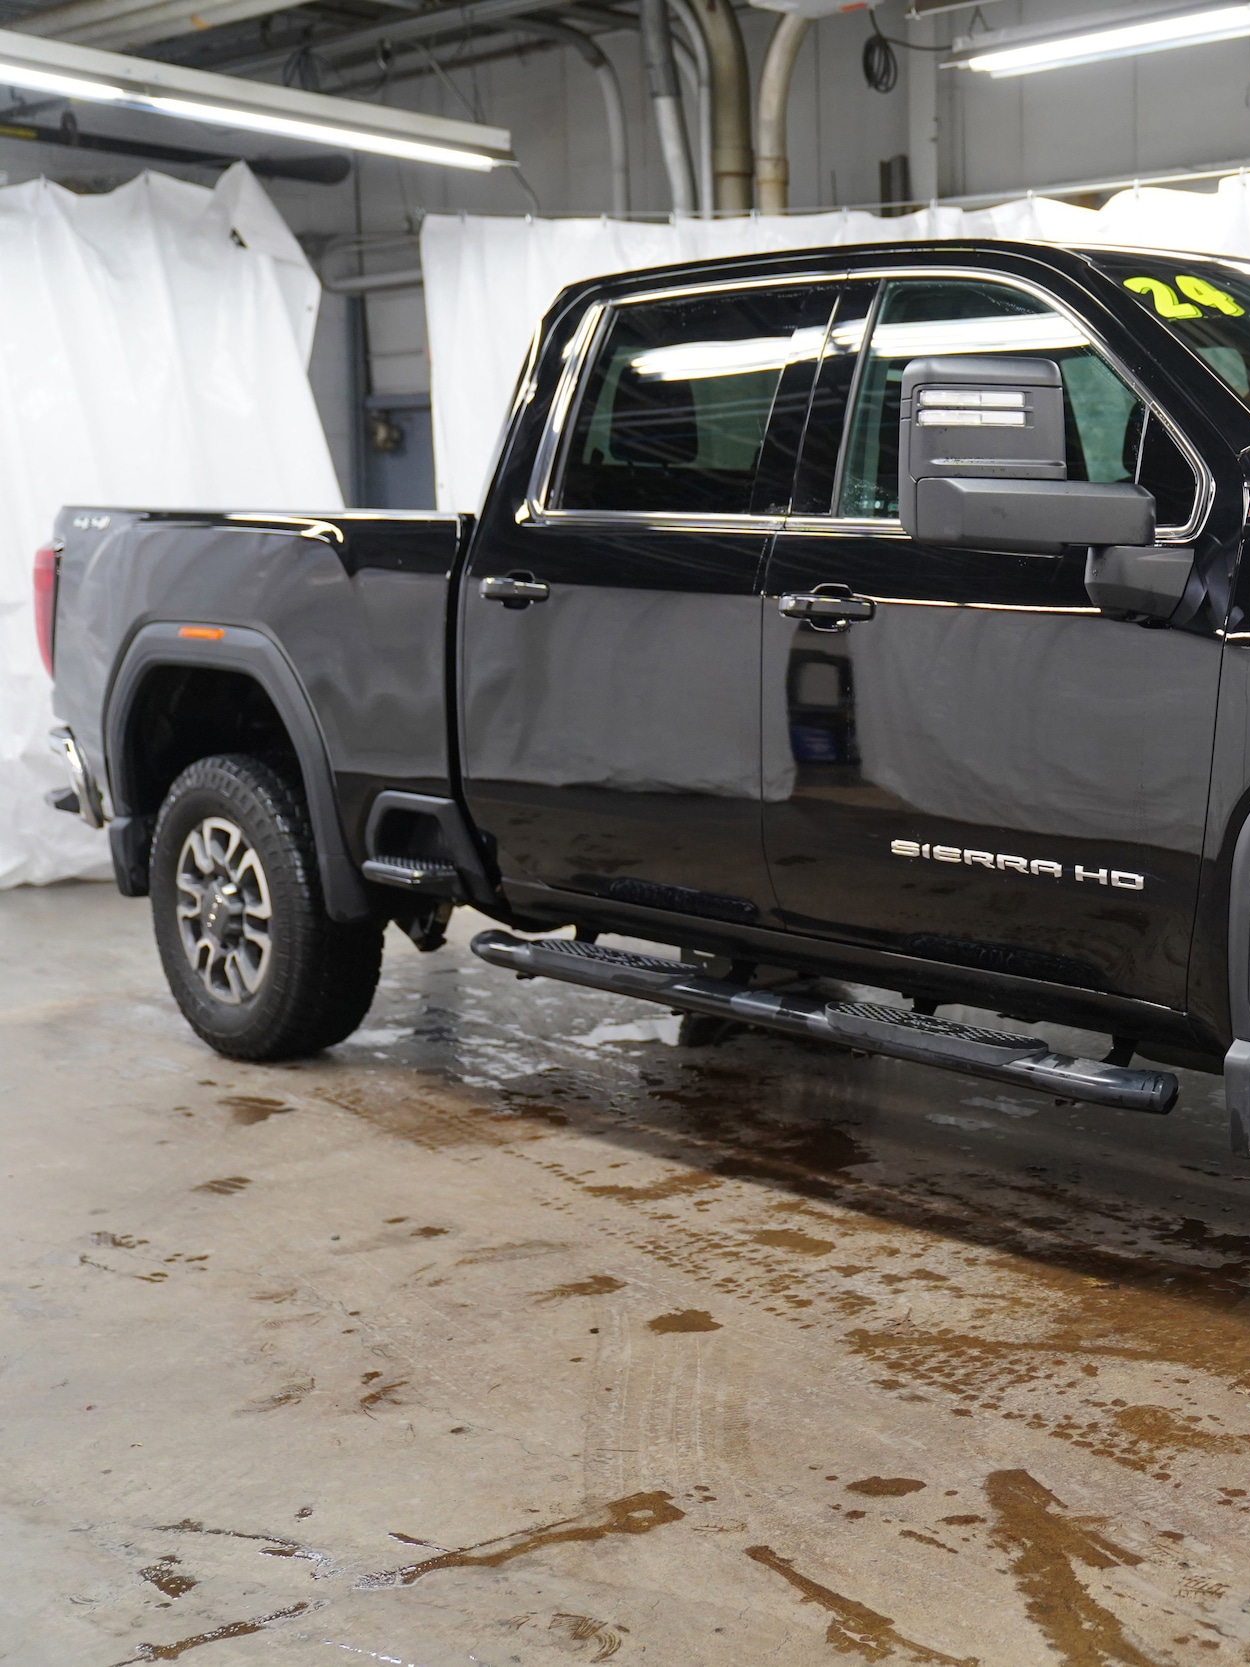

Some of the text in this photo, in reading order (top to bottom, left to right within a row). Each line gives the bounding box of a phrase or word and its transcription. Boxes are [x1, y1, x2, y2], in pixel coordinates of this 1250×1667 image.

[1123, 275, 1245, 318] 24
[890, 838, 1145, 891] SIERRA HD
